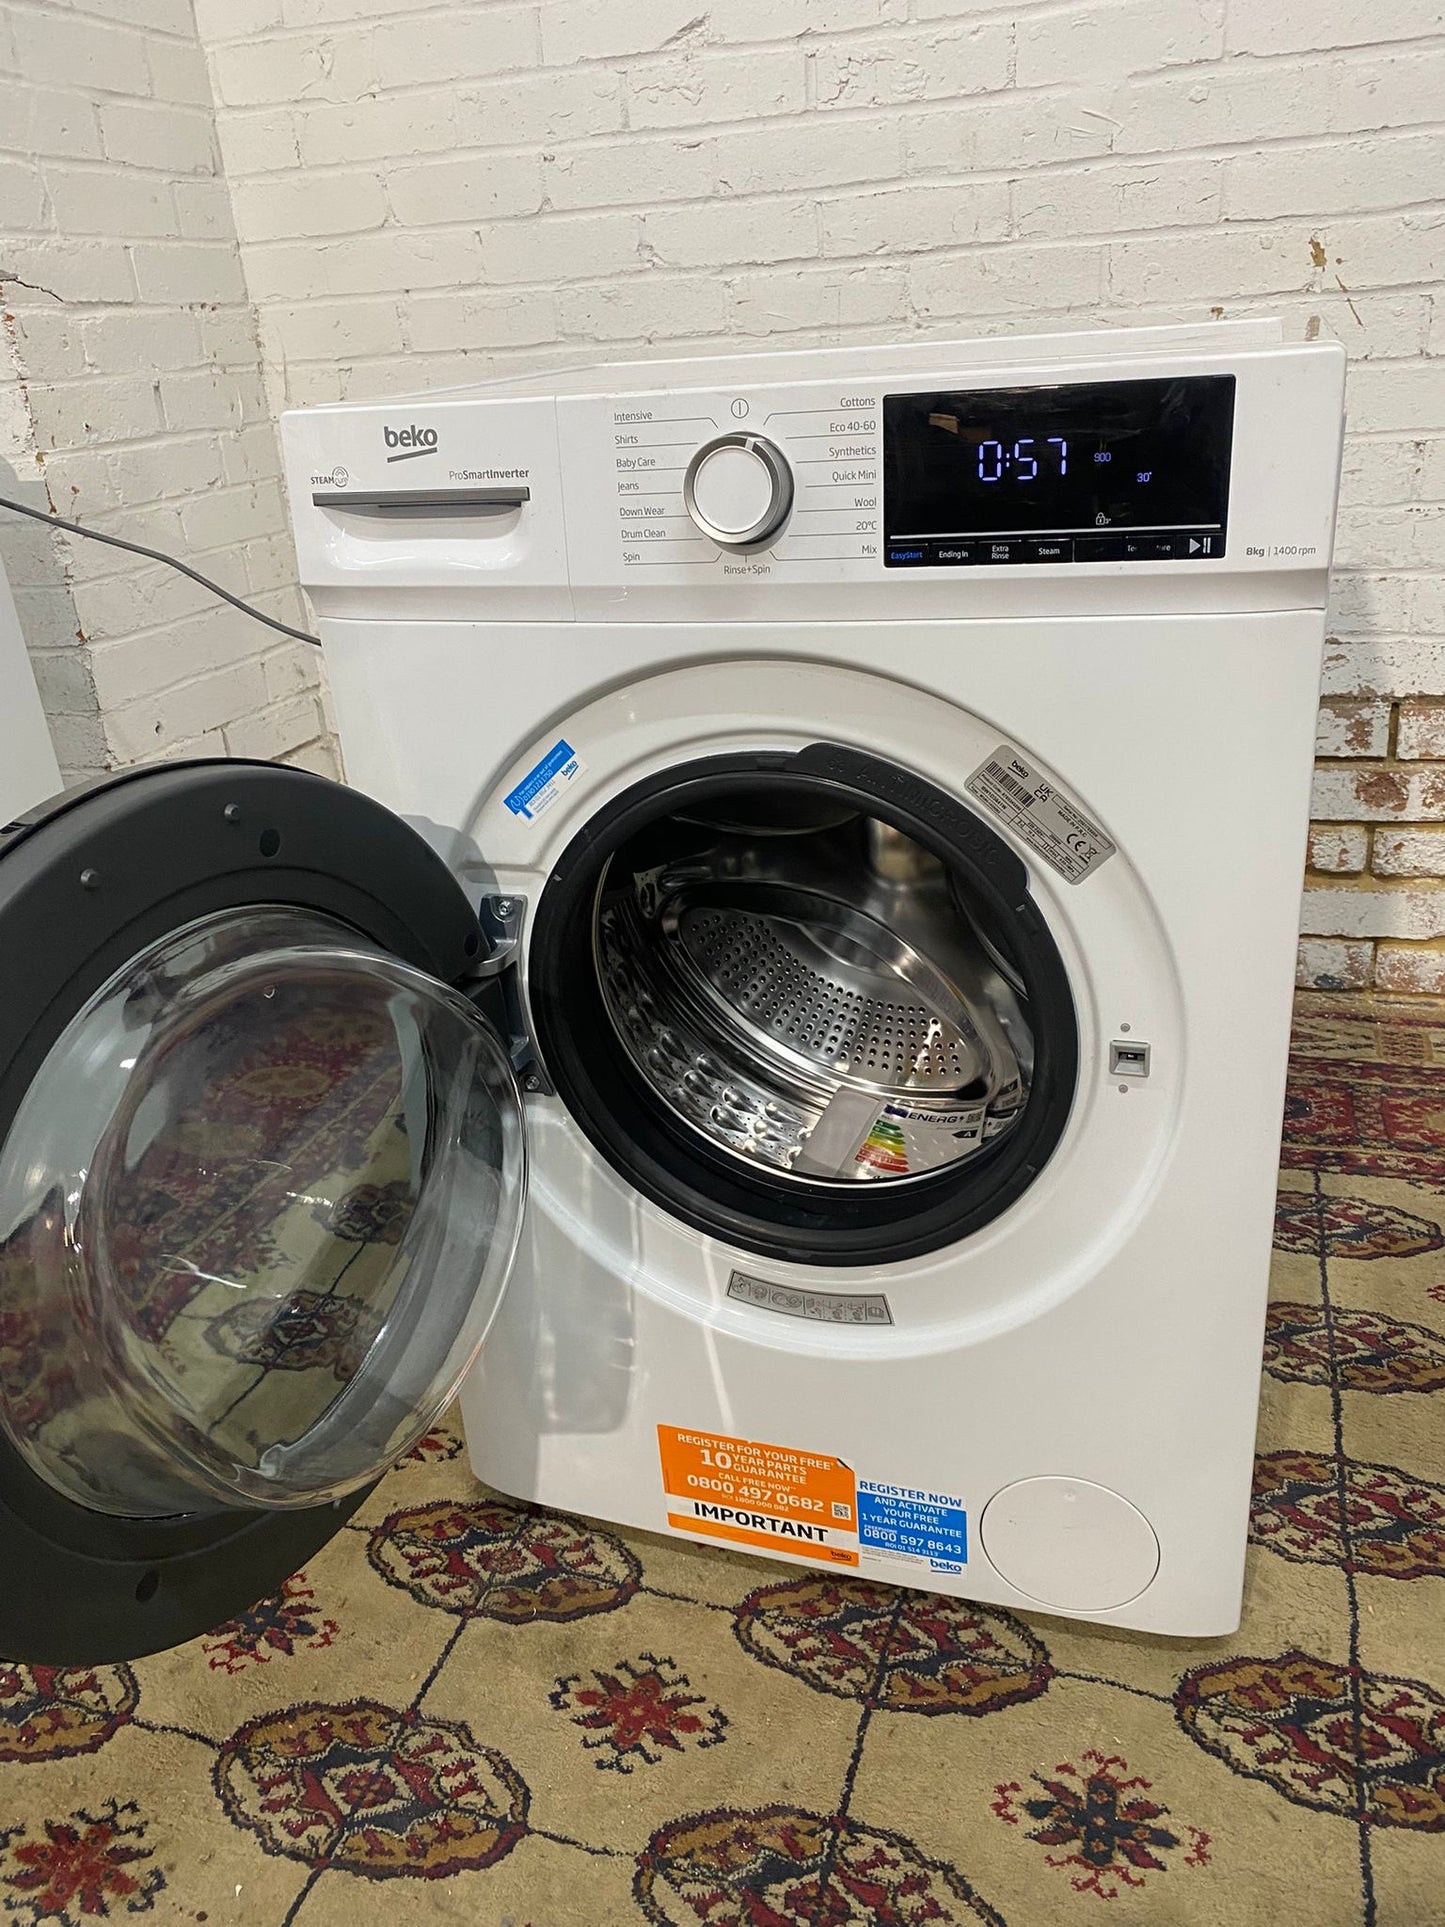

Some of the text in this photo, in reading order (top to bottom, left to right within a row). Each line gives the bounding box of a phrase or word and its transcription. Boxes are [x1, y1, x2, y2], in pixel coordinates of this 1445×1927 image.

[840, 398, 876, 408] Cottons
[614, 411, 652, 422] Intensive
[830, 420, 876, 432] Eco 40-60
[384, 425, 437, 447] beko
[614, 434, 638, 444] Shirts
[829, 446, 876, 458] Synthetics
[1094, 452, 1111, 462] 900
[616, 457, 656, 469] Baby Care
[978, 438, 1067, 481] 0:57
[310, 476, 334, 484] STEAM
[449, 469, 529, 480] ProSmartInverter
[832, 470, 877, 482] Quick Mini
[617, 482, 640, 493] Jeans
[854, 497, 877, 507] Wool
[620, 506, 665, 516] Down Wear
[621, 528, 666, 539] Drum Clean
[862, 544, 877, 554] Mix
[939, 550, 968, 559] Ending In
[992, 545, 1009, 553] Extra
[1246, 546, 1316, 557] 8kg 1400 rpm
[622, 552, 640, 562] Spin
[890, 552, 923, 560] EasyStart
[991, 552, 1009, 560] Rinse
[561, 760, 577, 776] beko
[1011, 760, 1029, 778] beko
[1034, 789, 1048, 802] CA
[1040, 784, 1054, 797] UK
[909, 1113, 957, 1123] ENERG
[677, 1433, 734, 1452] REGISTER
[737, 1445, 761, 1457] FOR
[763, 1450, 798, 1464] YOUR
[700, 1449, 731, 1470] 10
[732, 1454, 807, 1475] YEAR PARTS
[718, 1473, 741, 1483] CALL
[743, 1477, 766, 1487] FREE
[733, 1464, 807, 1484] GUARANTEE
[687, 1475, 824, 1512] 0800 497 0682
[860, 1481, 962, 1507] REGISTER NOW
[874, 1497, 948, 1516] AND ACTIVATE
[694, 1502, 828, 1542] IMPORTANT
[883, 1508, 939, 1524] YOUR FREE
[870, 1514, 897, 1526] YEAR
[899, 1520, 962, 1538] GUARANTEE
[864, 1529, 961, 1554] 0800 597 8643
[831, 1550, 852, 1560] beko
[930, 1559, 962, 1572] beko
